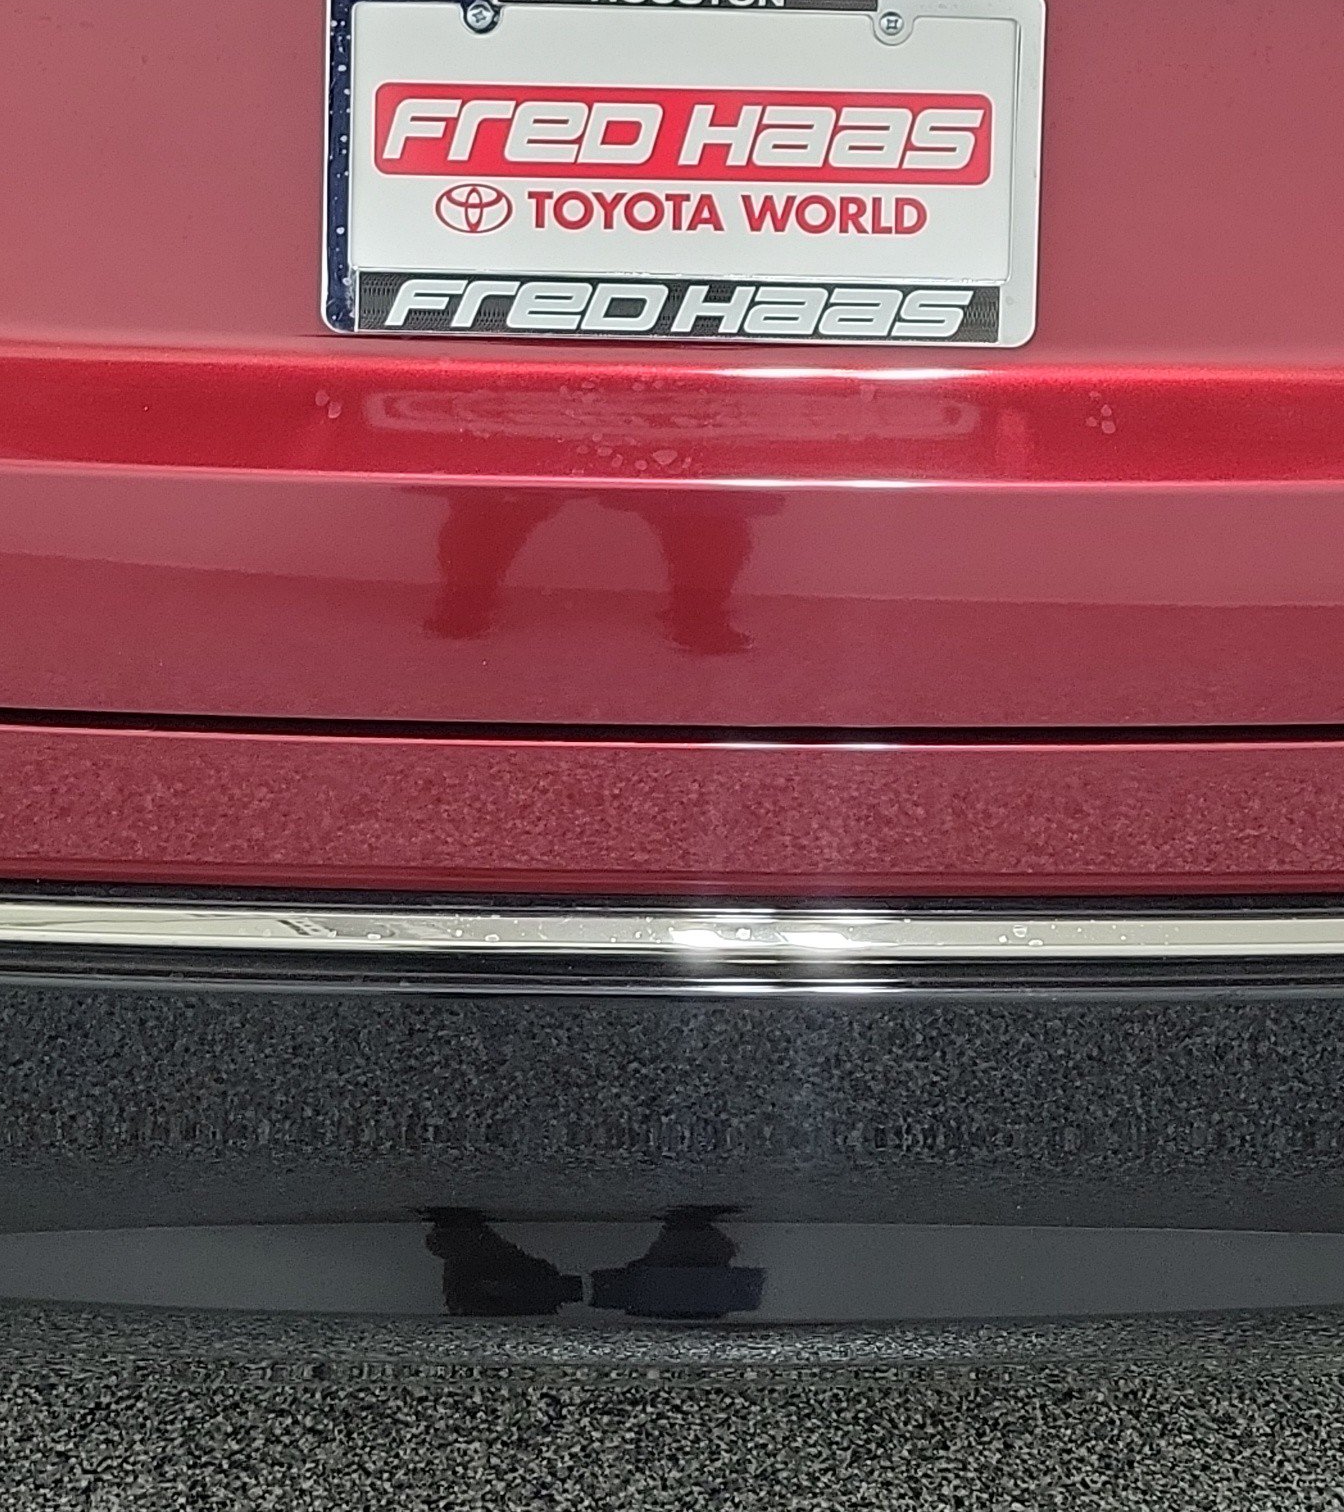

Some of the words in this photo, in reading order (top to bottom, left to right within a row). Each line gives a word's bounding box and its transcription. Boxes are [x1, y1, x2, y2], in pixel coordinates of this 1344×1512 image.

[382, 97, 664, 167] FreD
[677, 103, 986, 171] Haas
[526, 190, 725, 233] TOYOTA
[740, 194, 929, 236] WORLD
[384, 278, 669, 332] FreD
[670, 284, 975, 339] Haas
